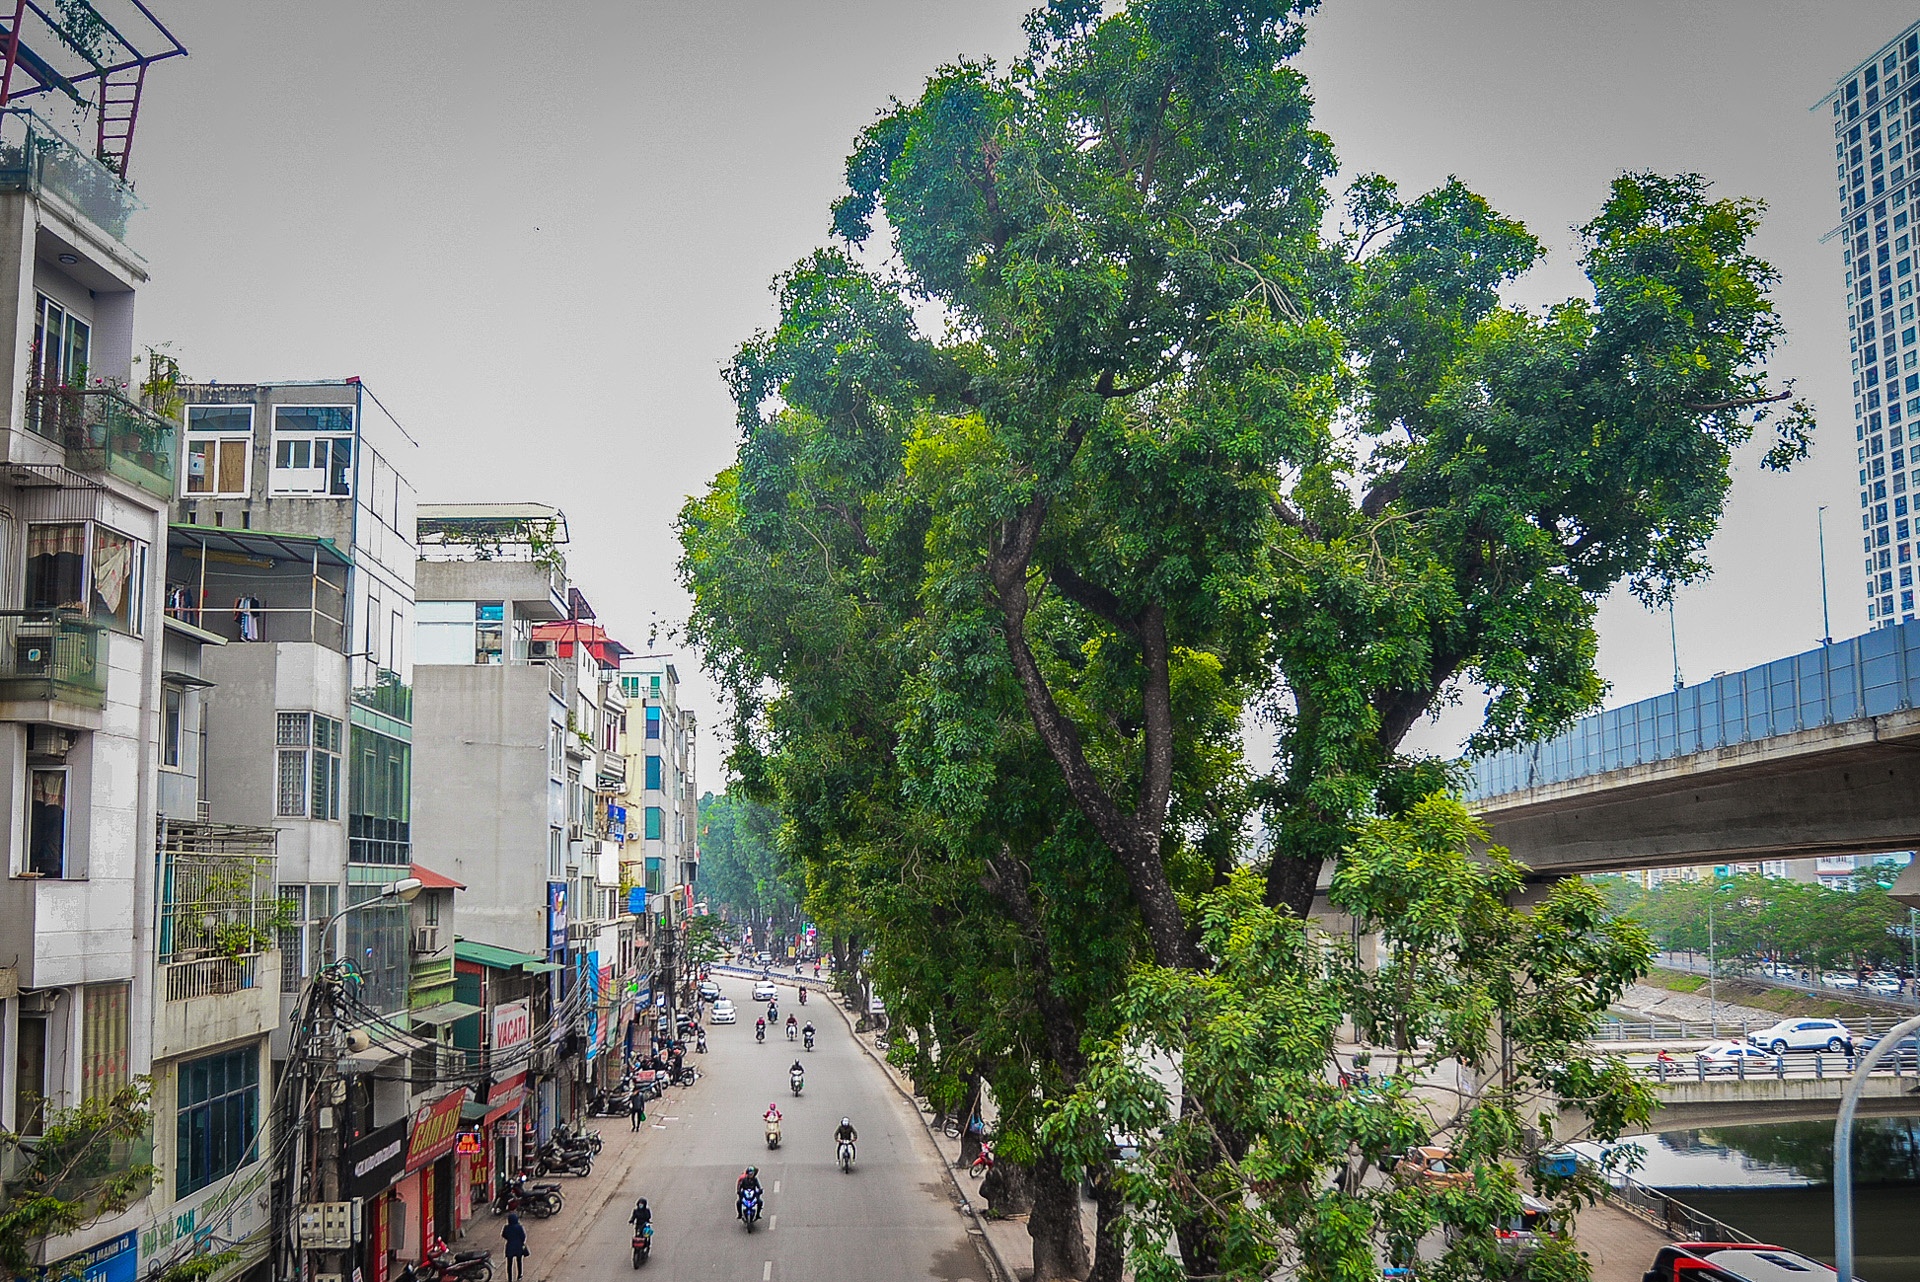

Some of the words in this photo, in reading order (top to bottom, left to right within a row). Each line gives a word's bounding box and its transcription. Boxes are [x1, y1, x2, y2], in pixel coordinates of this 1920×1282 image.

[497, 1014, 527, 1049] VACATA
[176, 1208, 195, 1240] 24H
[120, 1235, 129, 1252] TÚ
